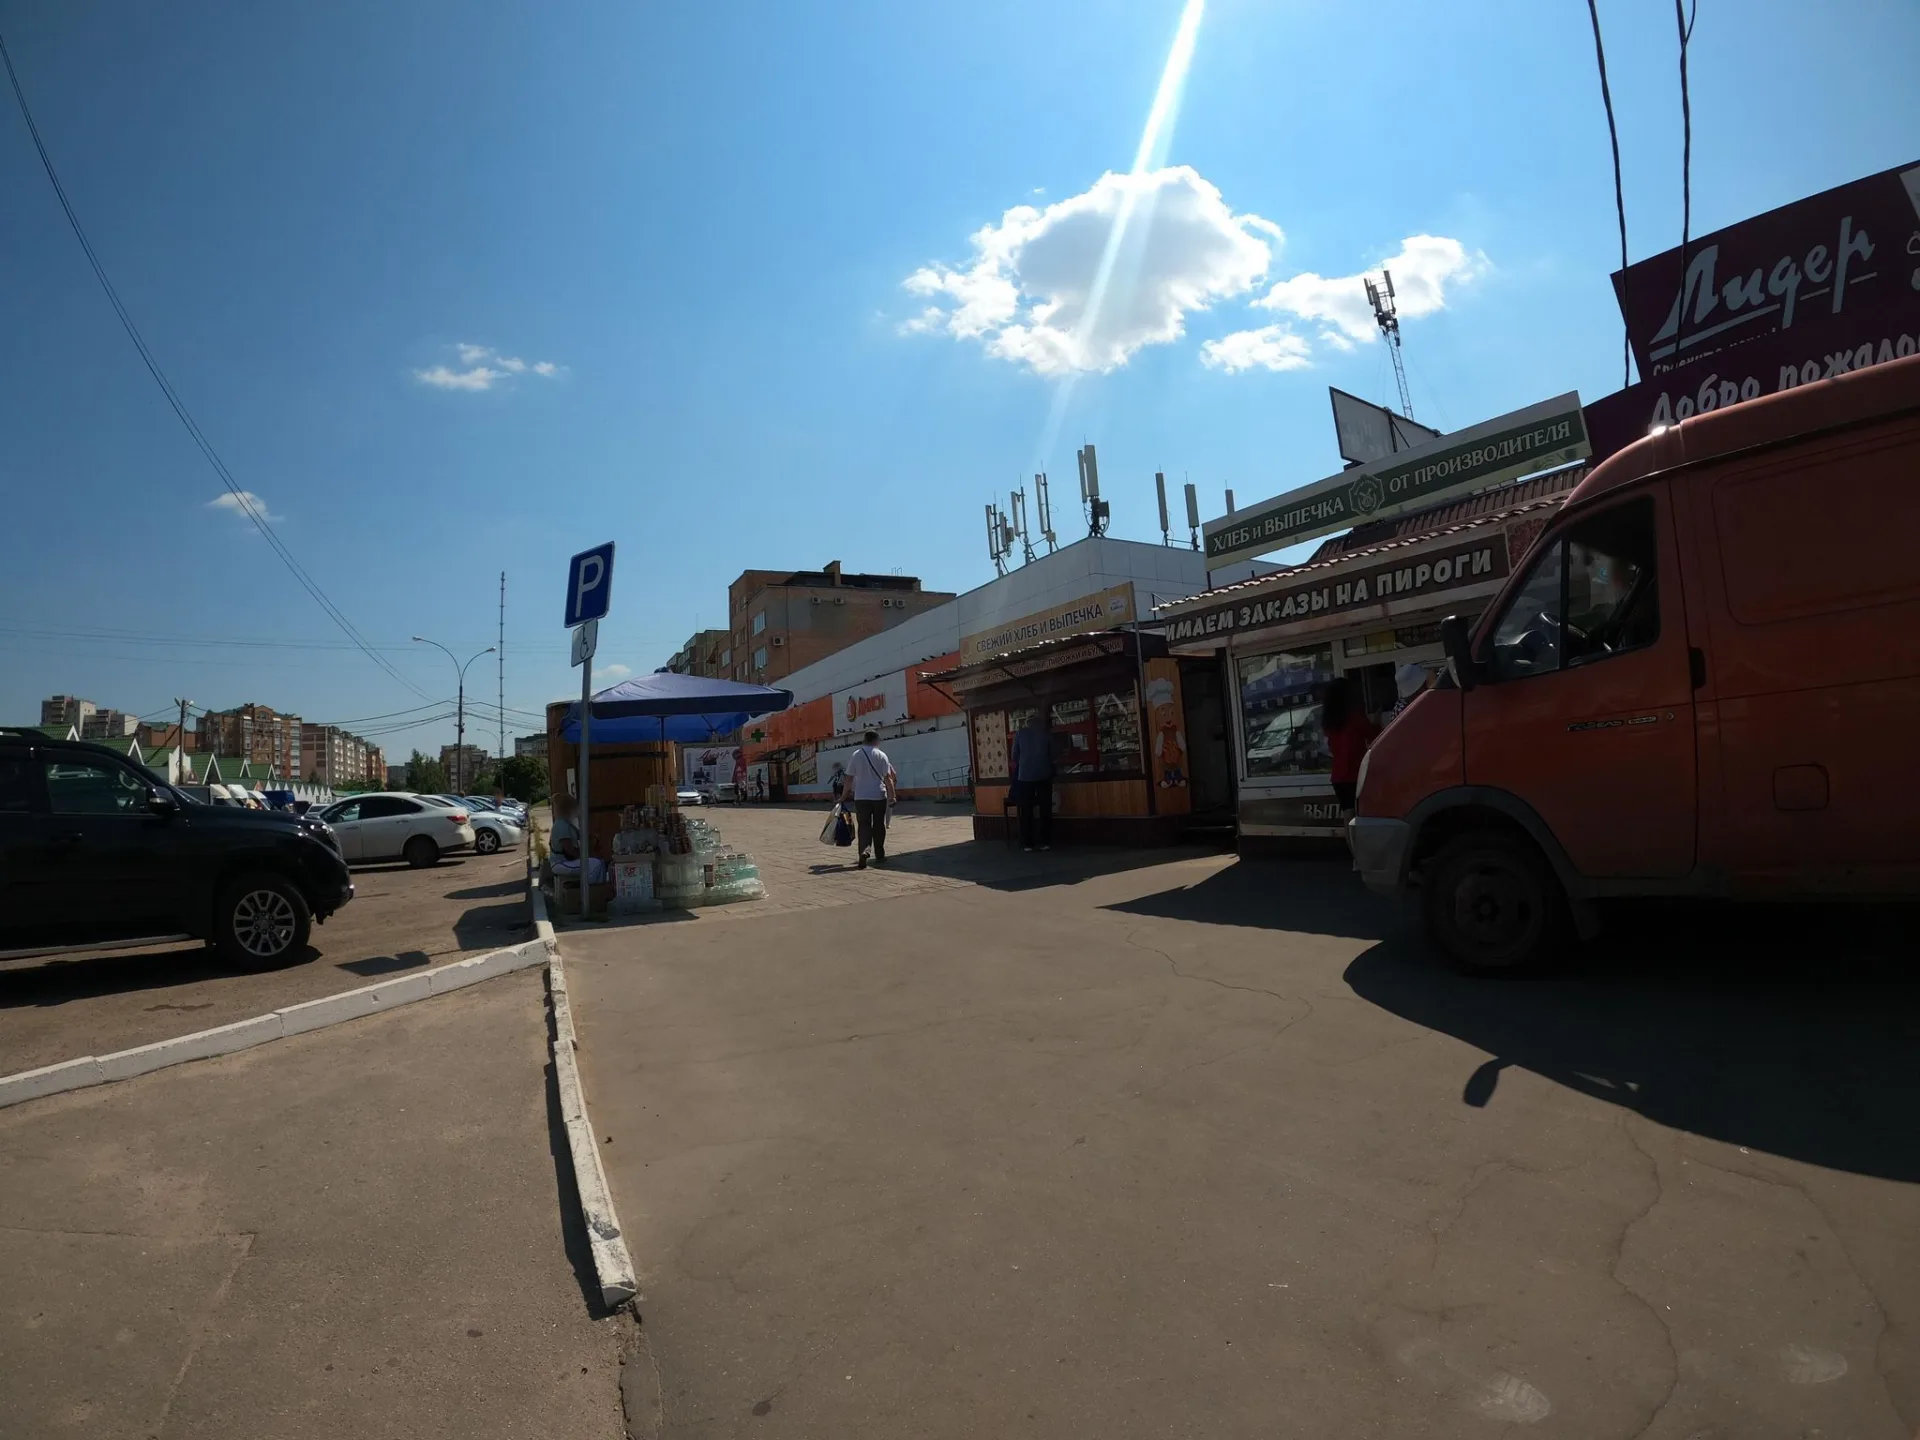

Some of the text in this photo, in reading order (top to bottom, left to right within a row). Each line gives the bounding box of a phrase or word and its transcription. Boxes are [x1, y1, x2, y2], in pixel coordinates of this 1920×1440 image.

[1649, 216, 1876, 329] Лидер
[1648, 374, 1761, 428] Добро
[1777, 333, 1920, 391] пожало
[1212, 526, 1249, 551] ХЛЕБ
[1264, 497, 1345, 536] ВЫПЕЧКА
[1388, 474, 1410, 494] ОТ
[1414, 420, 1572, 485] ПРОИЗВОДИТЕЛЯ
[575, 555, 604, 618] P
[1238, 588, 1330, 627] ЗАКАЗЫ
[1336, 578, 1368, 604] НА
[1376, 548, 1492, 597] ПИРОГИ
[976, 629, 1012, 653] СВЕЖИЙ
[1013, 623, 1038, 643] ХЛЕБ
[1040, 621, 1048, 634] И
[1049, 603, 1103, 631] ВЫПЕЧКА
[1303, 803, 1344, 820] ВЫП
